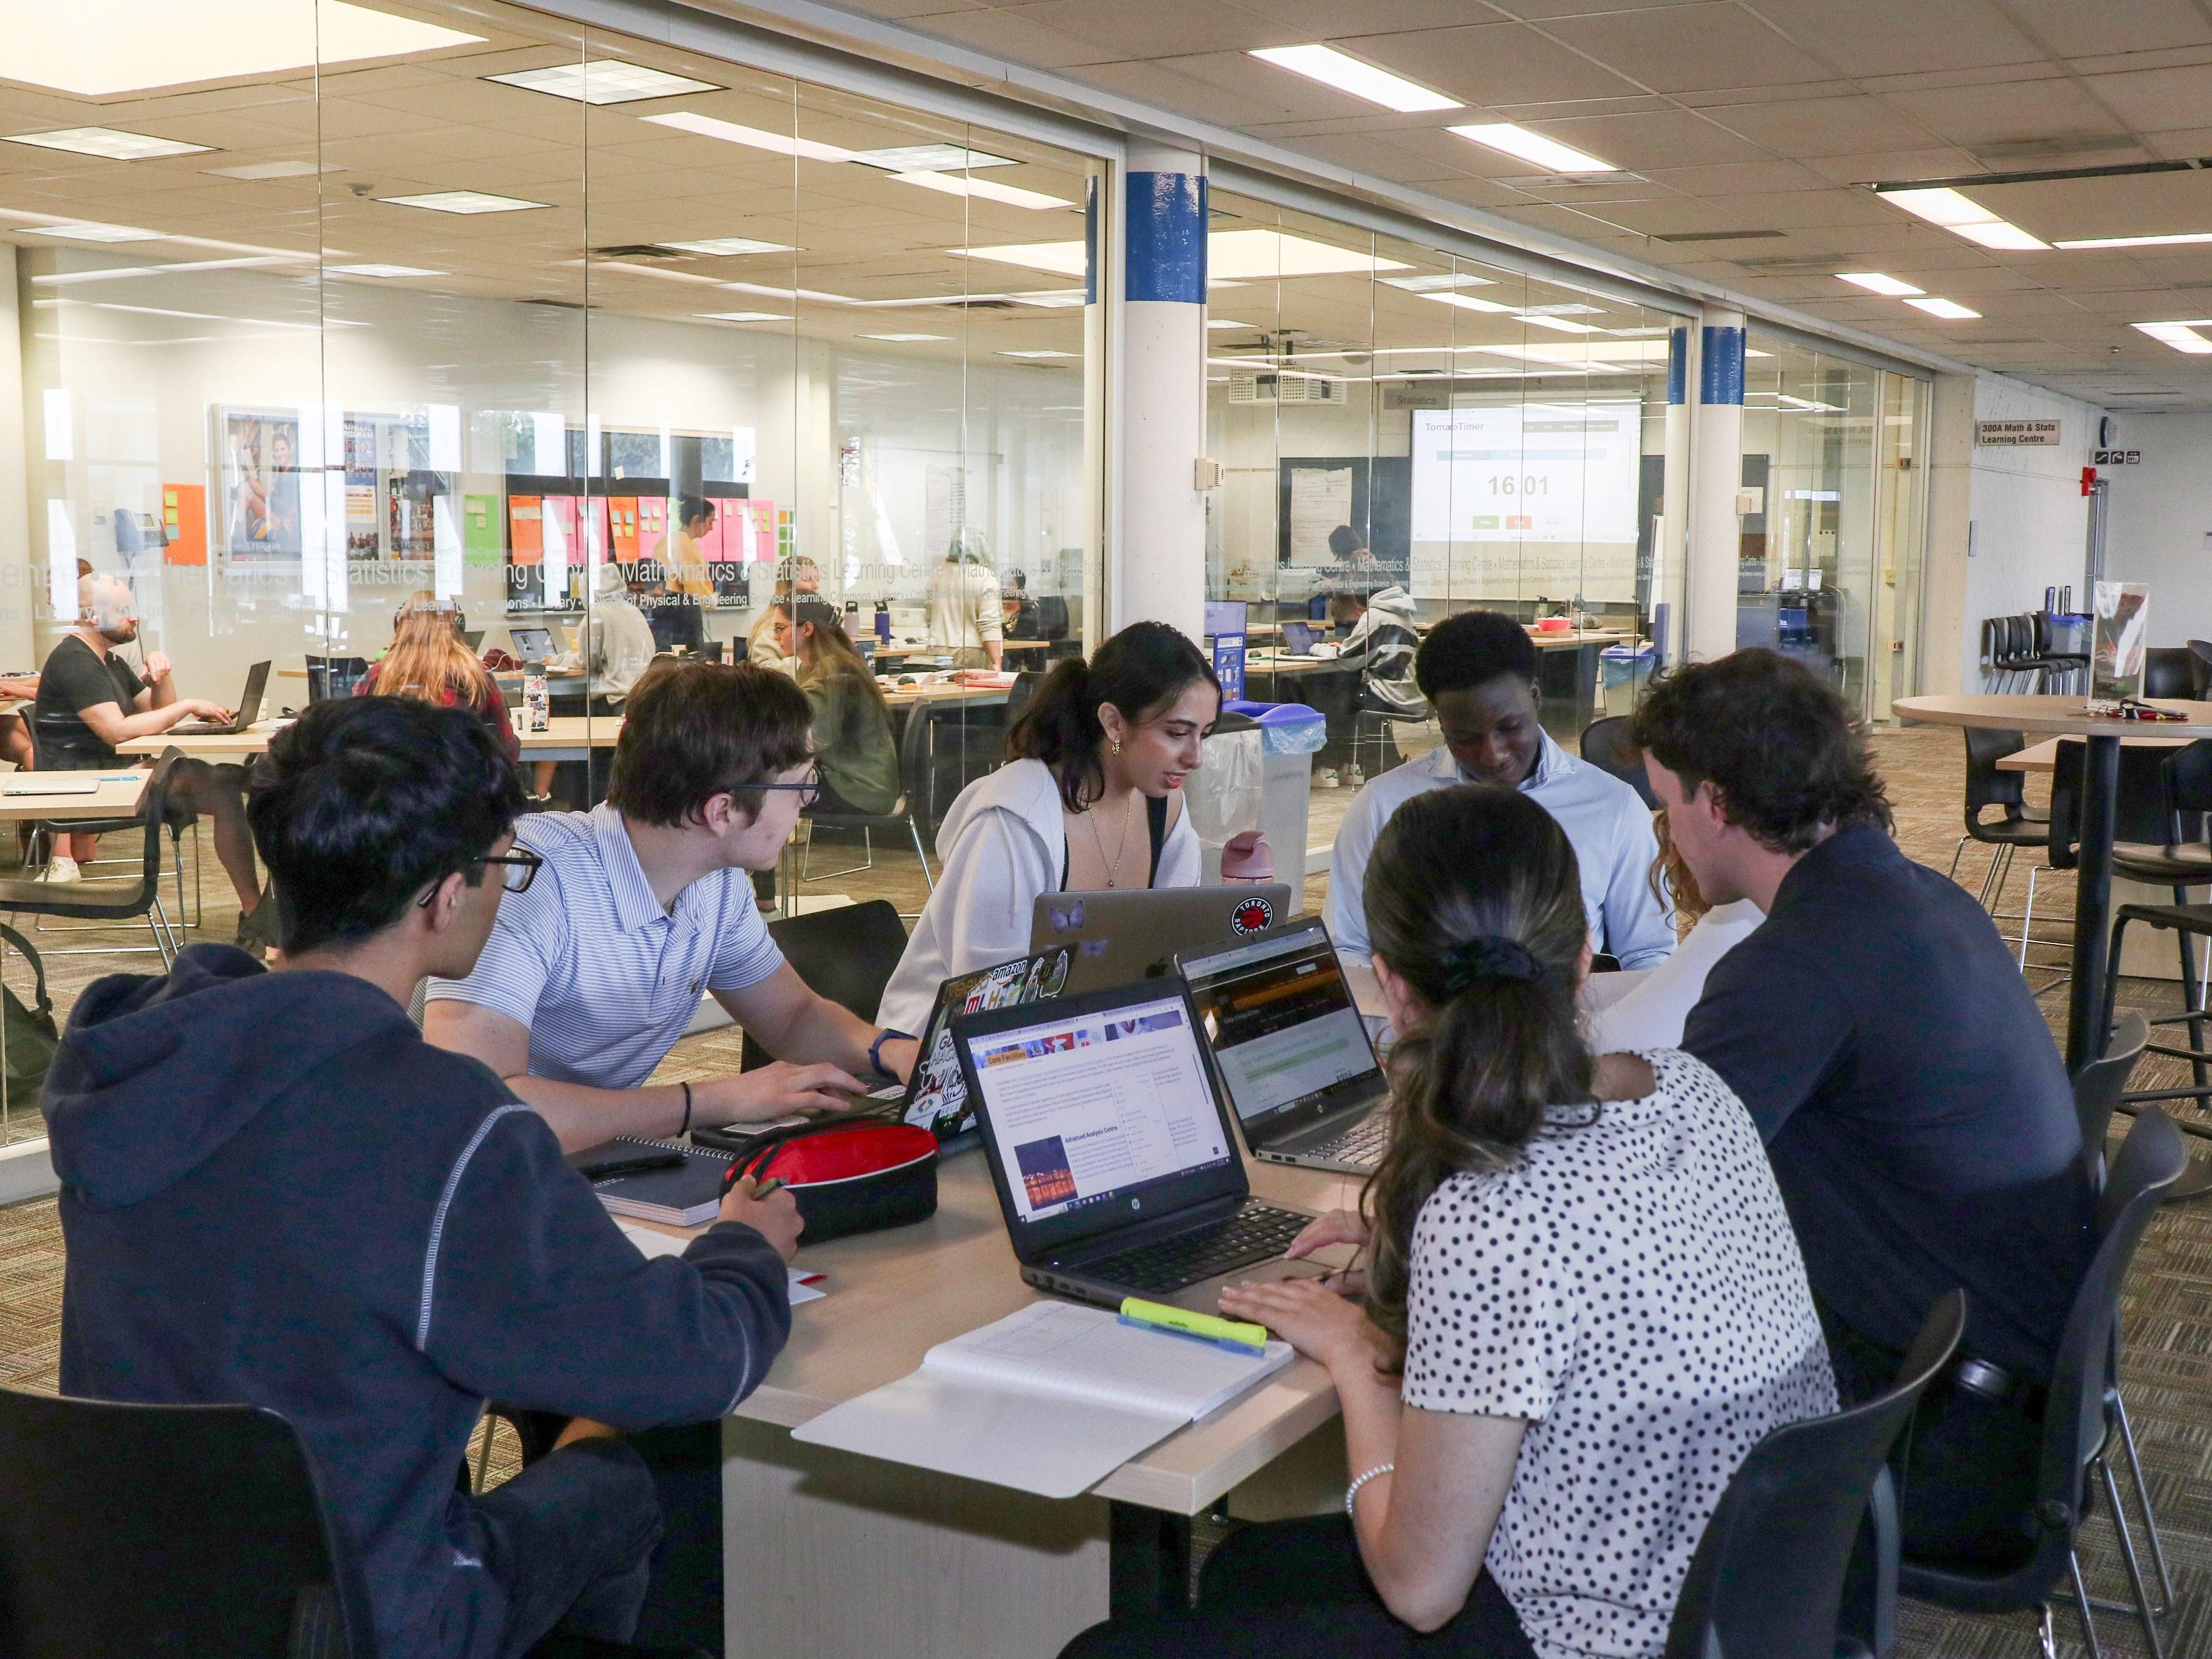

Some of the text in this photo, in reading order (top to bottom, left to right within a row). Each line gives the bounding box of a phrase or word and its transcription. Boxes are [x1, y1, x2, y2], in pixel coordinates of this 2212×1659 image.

[1397, 395, 1436, 405] Statistics
[1982, 435, 2044, 444] Learning Centre
[326, 556, 428, 585] Statistics
[622, 557, 735, 582] Mathematics
[758, 557, 828, 581] Statistics
[834, 558, 894, 584] Learning
[1358, 557, 1404, 573] Mathematics
[1412, 557, 1442, 572] Statistics
[640, 593, 680, 608] Physical
[683, 593, 690, 606] &
[692, 592, 747, 608] Engineering
[752, 592, 785, 604] Science
[791, 592, 828, 605] Learning
[831, 591, 871, 602] Commons
[1240, 900, 1270, 917] TORONTO
[993, 960, 1027, 981] amazon
[1065, 1133, 1086, 1143] Advanced
[1086, 1129, 1104, 1137] Analysis
